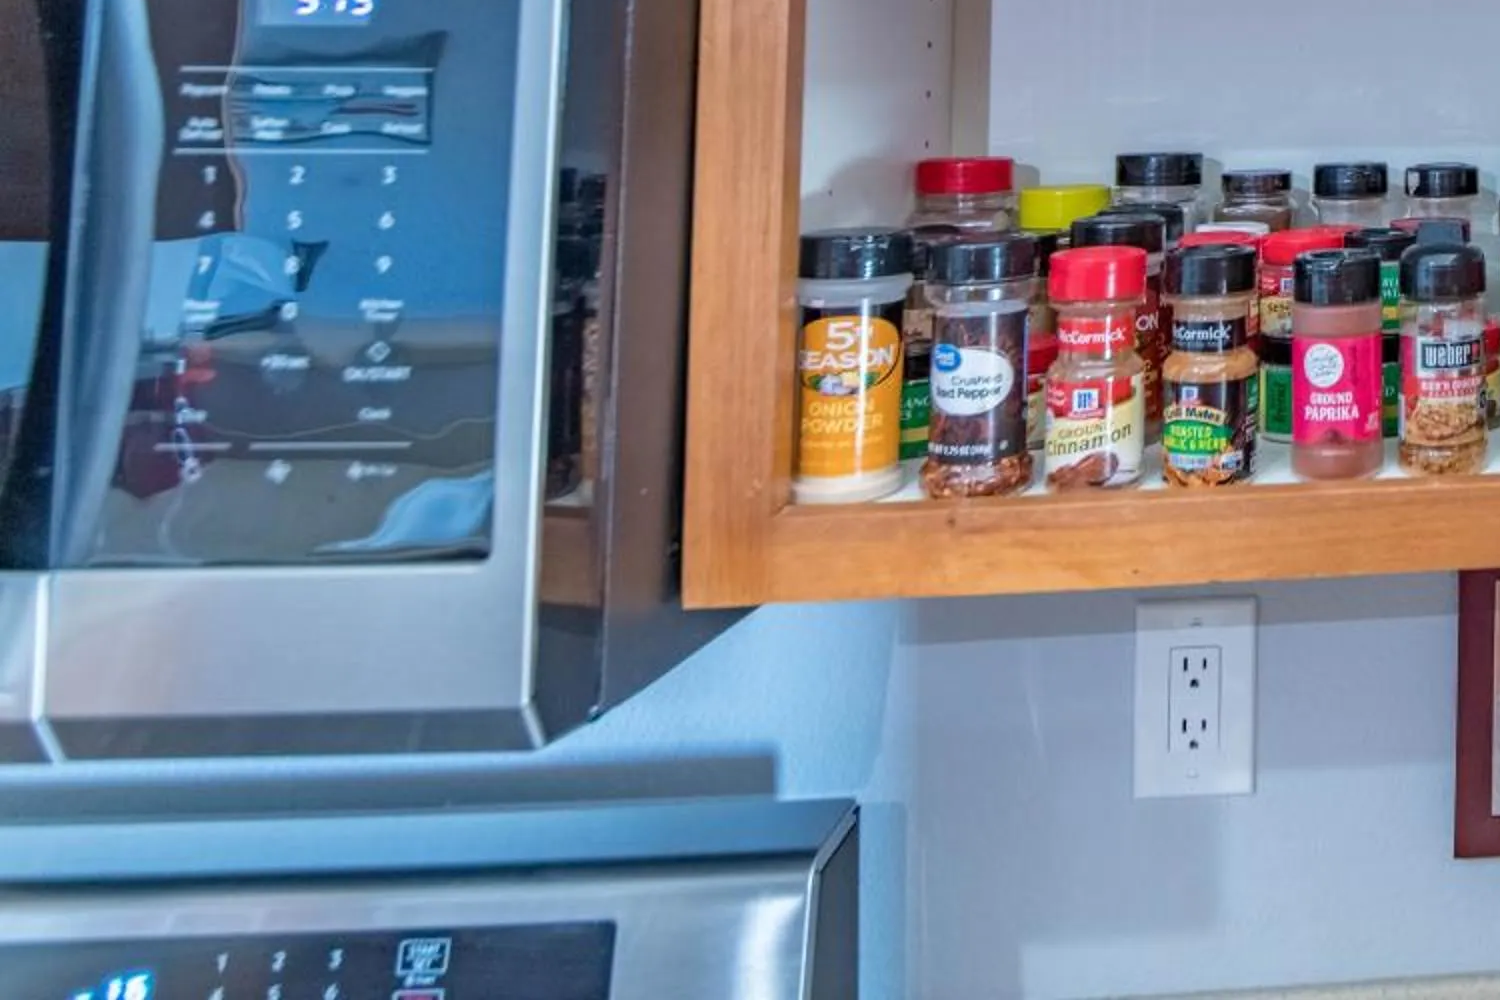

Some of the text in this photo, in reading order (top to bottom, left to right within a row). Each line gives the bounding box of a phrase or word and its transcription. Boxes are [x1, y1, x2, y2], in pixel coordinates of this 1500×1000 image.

[203, 165, 398, 186] 1 2 3
[198, 210, 395, 230] 4 5 6
[198, 256, 393, 275] 7 8 9
[1425, 342, 1471, 367] weber
[951, 375, 1003, 387] Crushed
[957, 386, 1003, 400] Pepper
[1304, 405, 1360, 422] PAPRIKA
[272, 950, 288, 973] 2
[329, 948, 344, 971] 3
